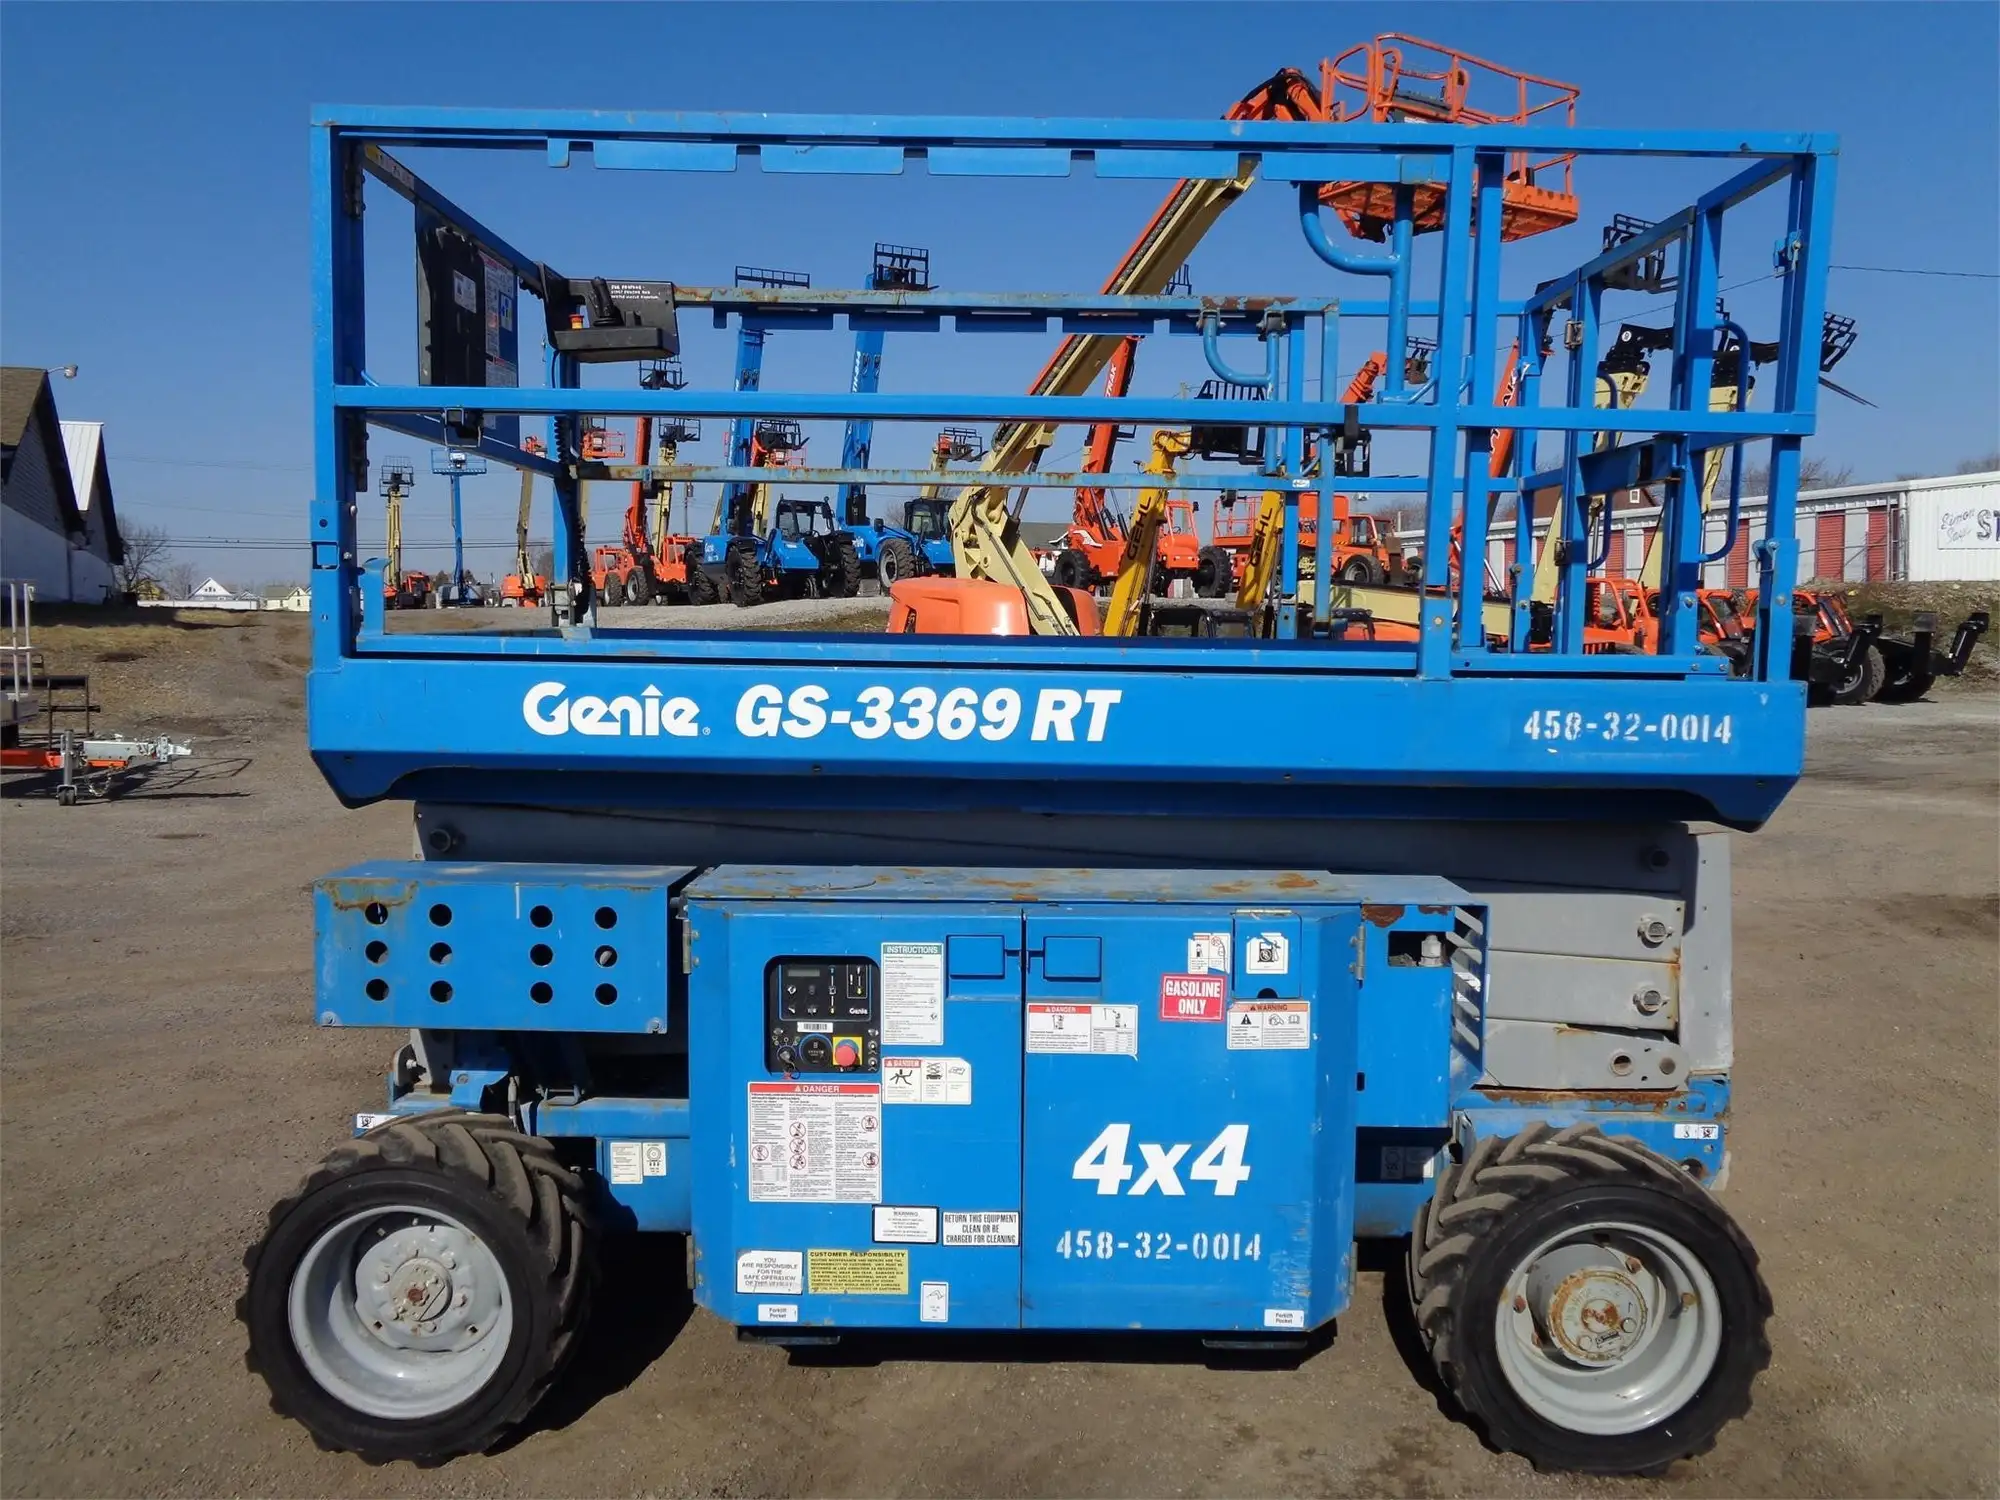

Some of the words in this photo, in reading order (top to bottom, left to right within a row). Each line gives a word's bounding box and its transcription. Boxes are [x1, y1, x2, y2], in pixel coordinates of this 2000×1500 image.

[1127, 496, 1152, 561] GEHL
[1249, 508, 1273, 566] GEHL
[522, 681, 701, 737] Genie
[734, 683, 1023, 741] GS-3369
[1030, 688, 1123, 741] RT
[1523, 710, 1733, 745] 458-32-0014
[886, 945, 939, 954] INSTRUCTIONS
[1165, 979, 1221, 998] GASOLINE
[1178, 998, 1208, 1015] ONLY
[1256, 1003, 1288, 1011] WARNING
[802, 1085, 840, 1093] DANGER
[1071, 1123, 1251, 1196] 4x4
[944, 1213, 968, 1223] RETURN
[969, 1214, 982, 1223] THIS
[983, 1214, 1017, 1224] EQUIPMENT
[962, 1224, 981, 1233] CLEAN
[982, 1224, 991, 1233] OR
[992, 1224, 1000, 1234] BE
[946, 1234, 972, 1243] CHARGED
[973, 1234, 985, 1243] FOR
[986, 1235, 1016, 1244] CLEANING
[1056, 1230, 1261, 1261] 458-32-0014
